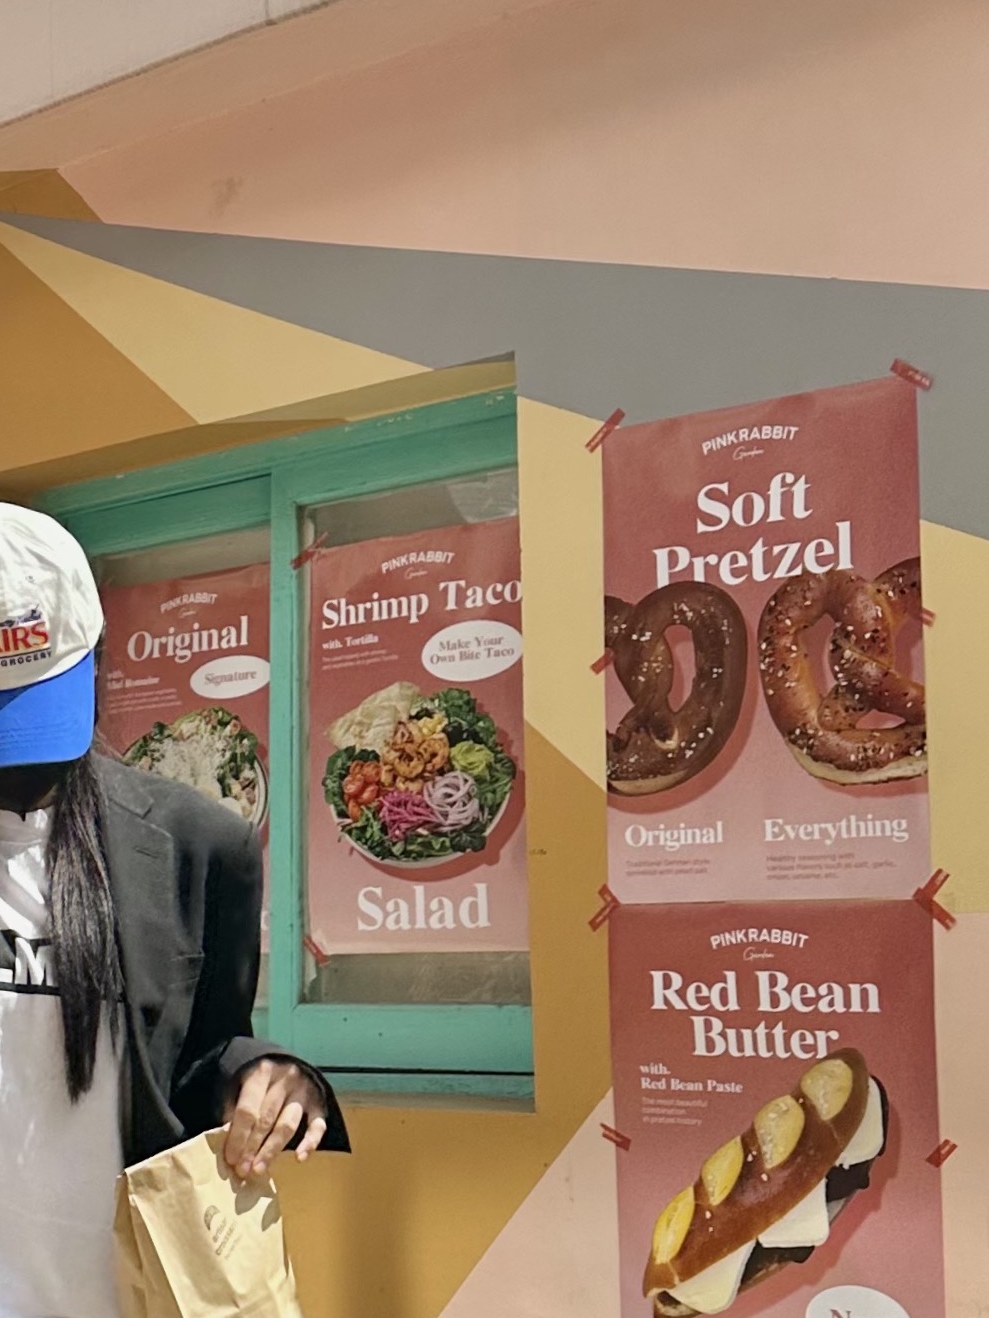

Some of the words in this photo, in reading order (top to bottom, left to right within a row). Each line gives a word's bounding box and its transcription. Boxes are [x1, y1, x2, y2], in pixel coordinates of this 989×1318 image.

[702, 425, 799, 456] PINKRABBIT
[696, 472, 813, 534] Soft
[381, 551, 455, 574] PINKRABBIT
[652, 520, 854, 587] Pretzel
[160, 591, 218, 614] PINKRABBIT
[321, 592, 430, 630] Shrimp
[439, 579, 523, 611] Taco
[127, 615, 249, 663] Original
[439, 641, 471, 651] Make
[474, 636, 505, 647] Your
[0, 651, 52, 667] GROCERY
[430, 653, 455, 665] Own
[459, 649, 481, 661] Bite
[485, 647, 515, 658] Taco
[204, 670, 257, 686] Signature
[625, 820, 723, 851] Original
[764, 814, 909, 845] Everything
[357, 883, 491, 932] Salad
[710, 928, 810, 950] PINKRABBIT
[649, 969, 740, 1012] Red
[756, 970, 881, 1014] Bean
[691, 1015, 840, 1060] Butter
[639, 1063, 671, 1075] with.
[640, 1077, 666, 1089] Red
[671, 1078, 703, 1091] Bean
[707, 1079, 744, 1093] Paste
